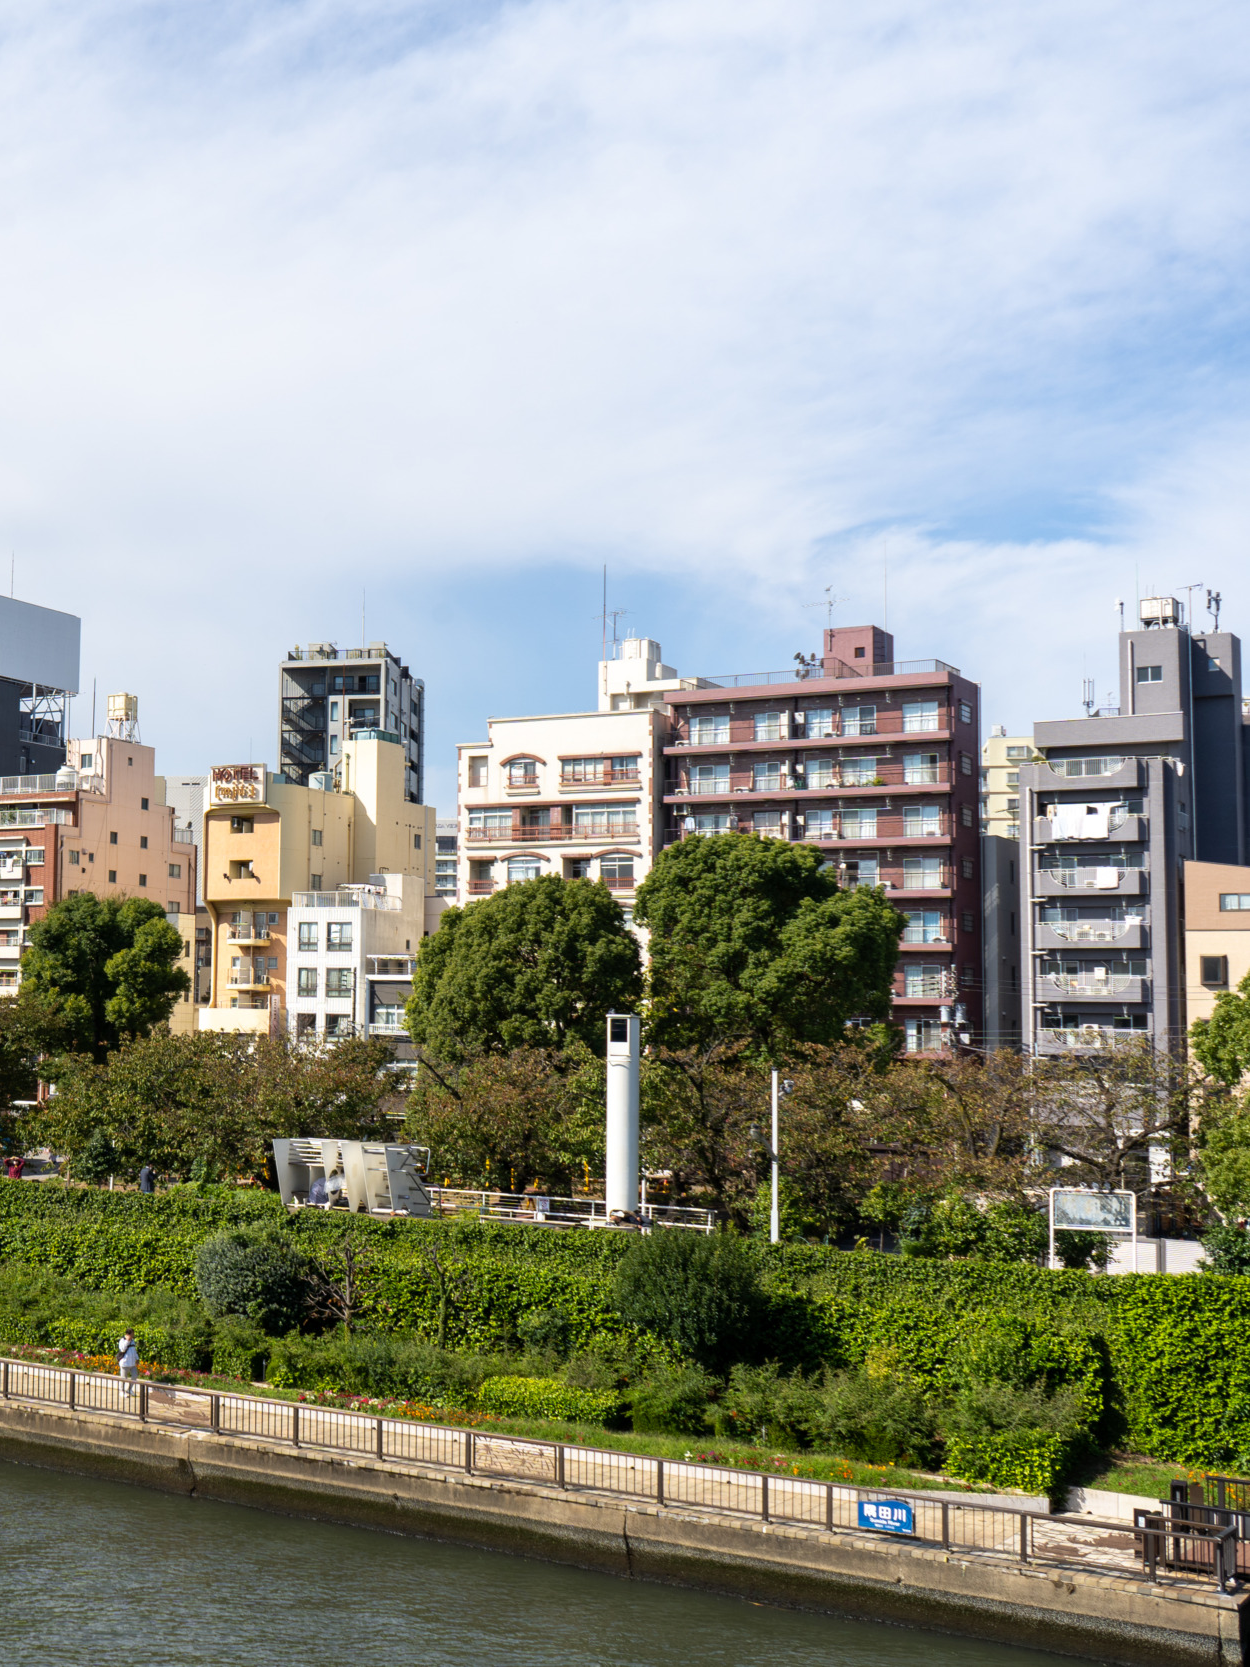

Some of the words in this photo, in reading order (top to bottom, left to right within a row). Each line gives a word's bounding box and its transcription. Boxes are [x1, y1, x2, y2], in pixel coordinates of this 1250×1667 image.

[213, 767, 259, 782] HOTEL
[863, 1503, 906, 1522] 隅田川
